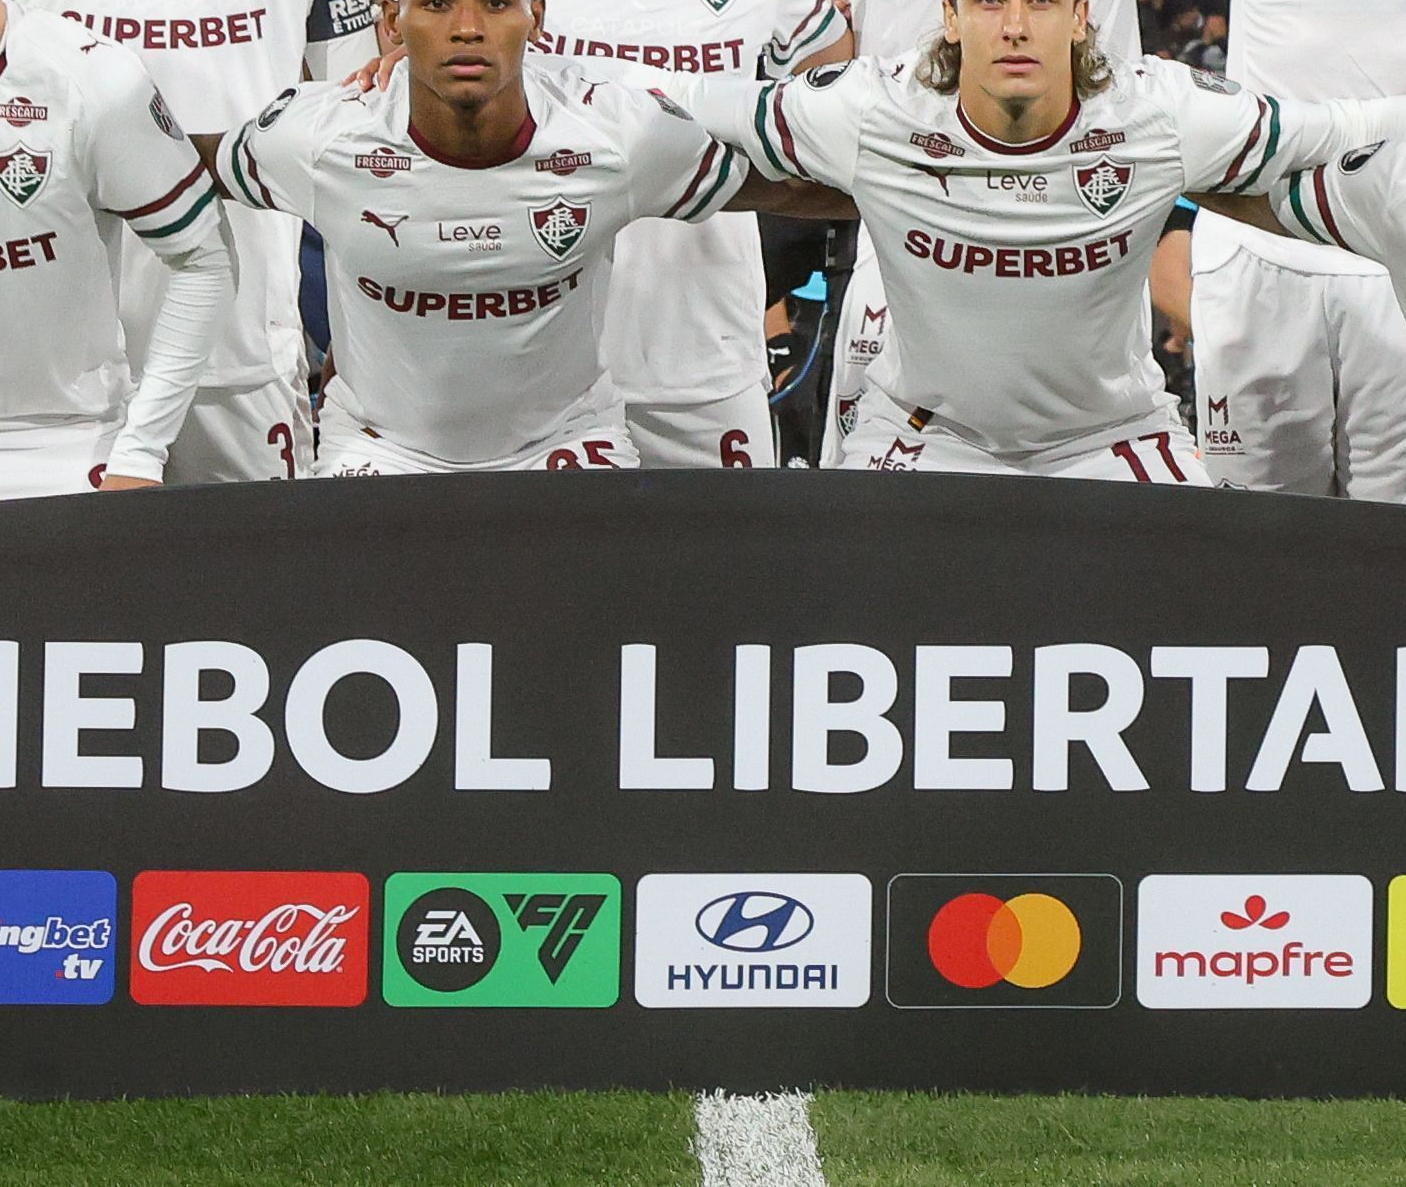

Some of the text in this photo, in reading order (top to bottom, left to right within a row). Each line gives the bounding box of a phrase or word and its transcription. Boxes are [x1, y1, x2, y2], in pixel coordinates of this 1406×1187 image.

[910, 134, 964, 156] FRESCATTO
[1070, 131, 1124, 153] FRESCATTO
[355, 155, 411, 171] FRESCATTO
[986, 170, 1048, 192] Leve
[438, 222, 502, 242] Leve
[904, 229, 1133, 277] SUPERBET
[357, 267, 583, 321] SUPERBET
[849, 338, 884, 355] MEG
[1205, 430, 1242, 444] MEGA
[1111, 431, 1188, 483] 17
[138, 903, 360, 973] Coca-Cola
[416, 910, 484, 946] EA
[412, 945, 485, 965] SPORTS
[1155, 941, 1354, 984] mapfre
[668, 964, 838, 990] HYUNDAI
